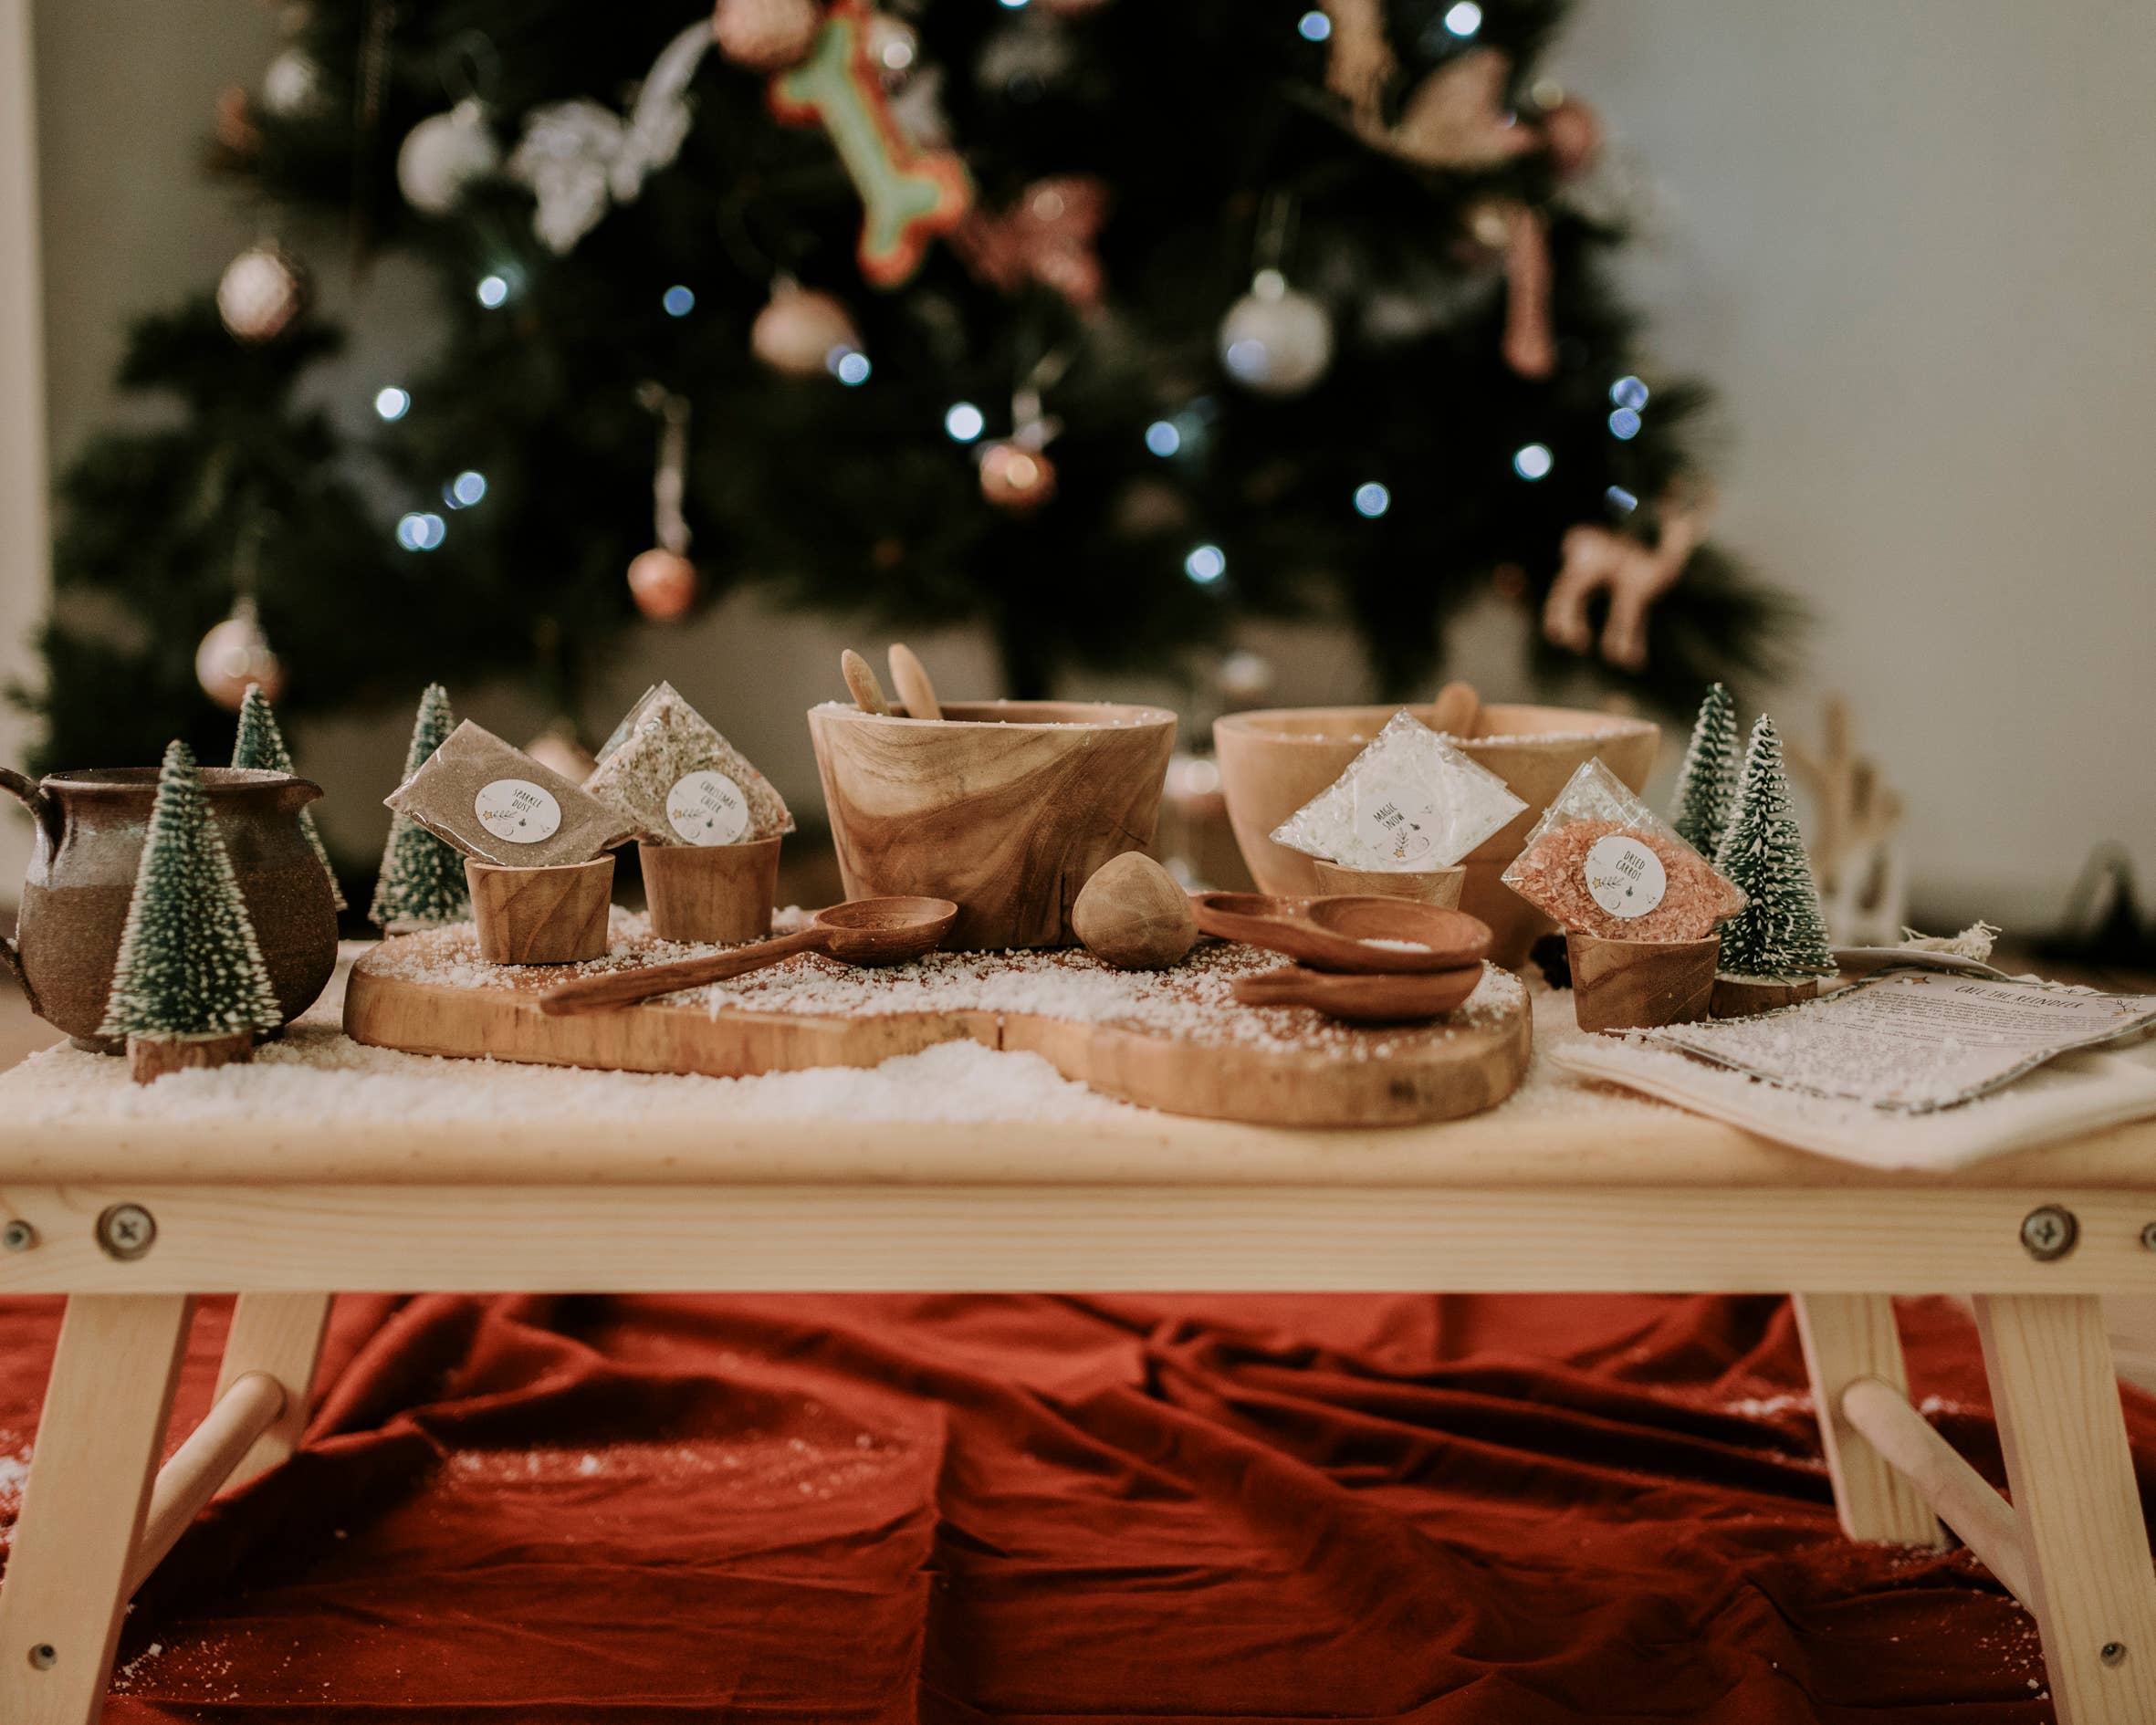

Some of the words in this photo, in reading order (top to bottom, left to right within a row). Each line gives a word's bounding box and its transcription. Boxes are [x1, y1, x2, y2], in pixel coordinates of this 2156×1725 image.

[512, 788, 543, 809] SPARKLE
[700, 780, 738, 810] CHRISTMAS
[700, 795, 723, 813] CHEER
[511, 799, 534, 813] DUST
[1373, 801, 1398, 823] MAGIC
[1382, 811, 1405, 831] SNOW
[1623, 850, 1646, 870] DRIED
[1615, 860, 1642, 882] CARROT
[1954, 985, 1986, 996] CALL
[1988, 989, 2013, 1000] THE
[2014, 994, 2085, 1009] REINDEER
